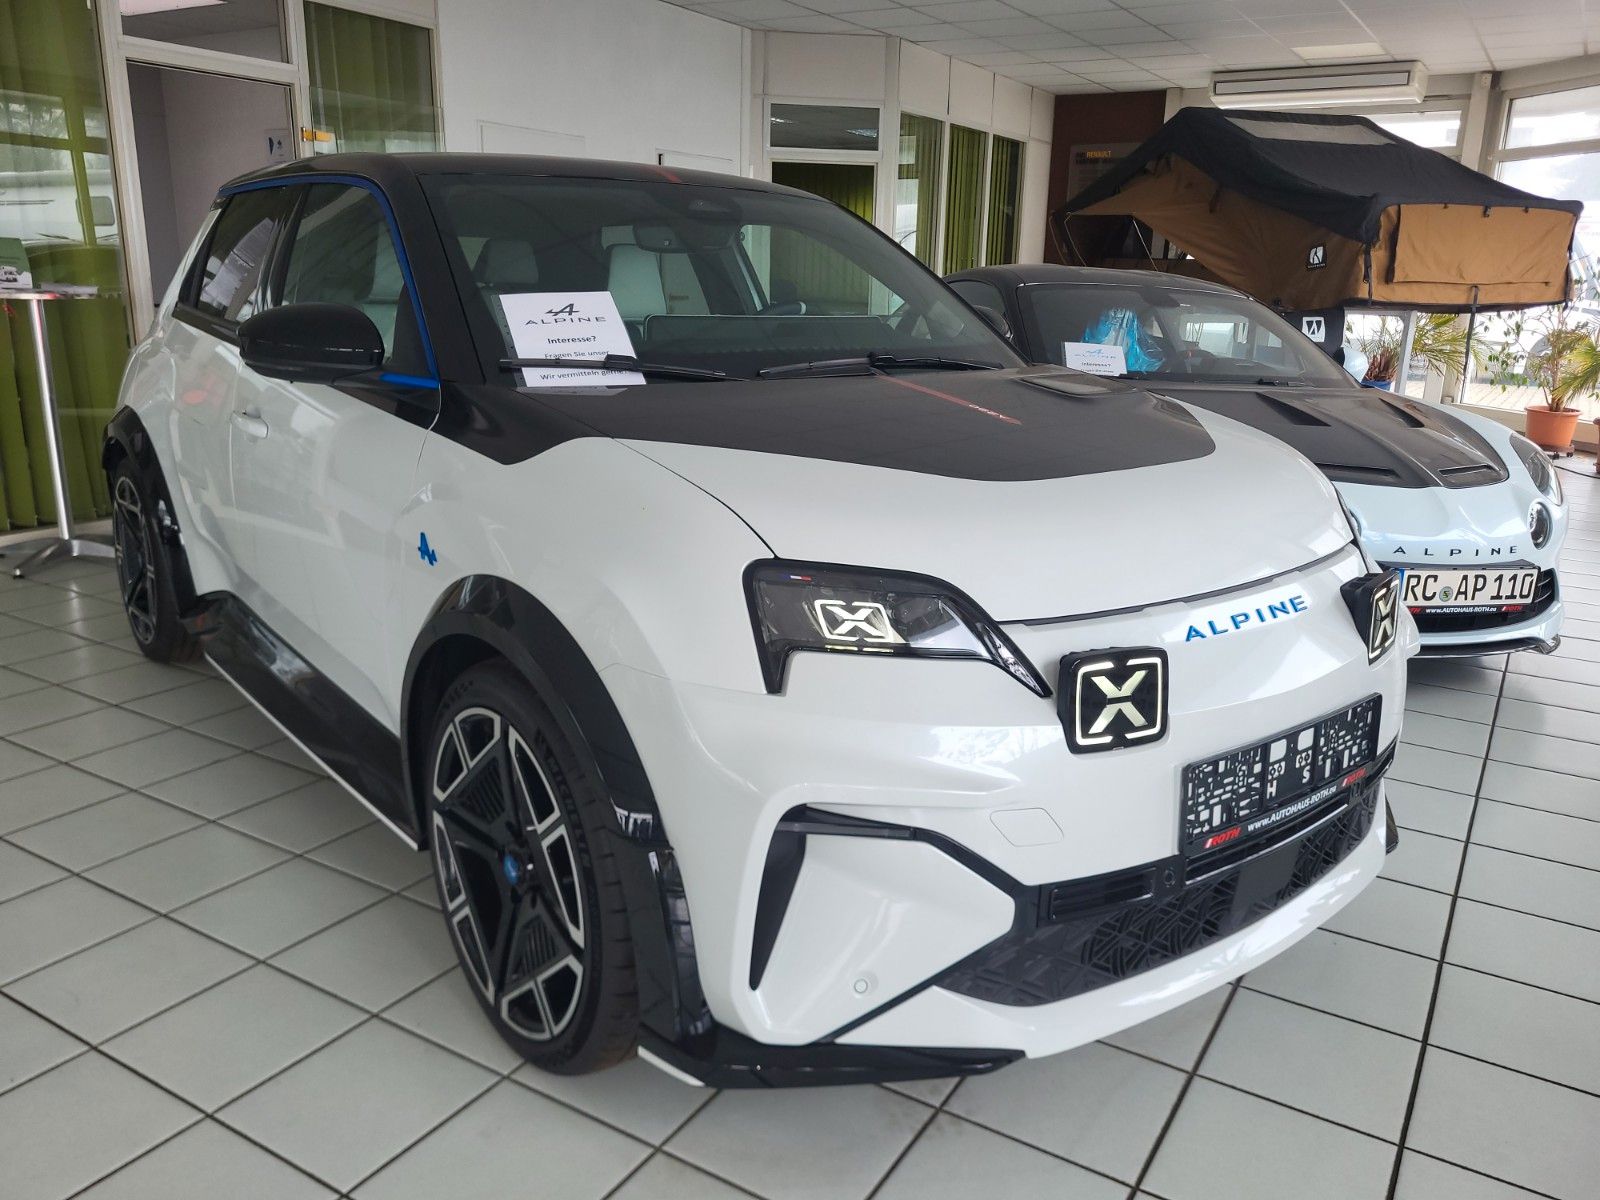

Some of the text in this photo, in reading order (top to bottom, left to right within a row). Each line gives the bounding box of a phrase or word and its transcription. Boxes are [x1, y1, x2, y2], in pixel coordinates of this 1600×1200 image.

[525, 316, 607, 326] ALPINE
[547, 335, 597, 345] Interesse?
[557, 370, 600, 379] vermitteln
[1392, 545, 1518, 557] ALPINE
[1403, 573, 1535, 602] RC AP 110
[1425, 606, 1497, 614] www.AUTOHAUS-ROTH.eu
[1185, 595, 1308, 642] ALPINE
[1206, 827, 1242, 848] ROTH
[1247, 785, 1337, 832] www.AUTOHAUS-ROTH.eu
